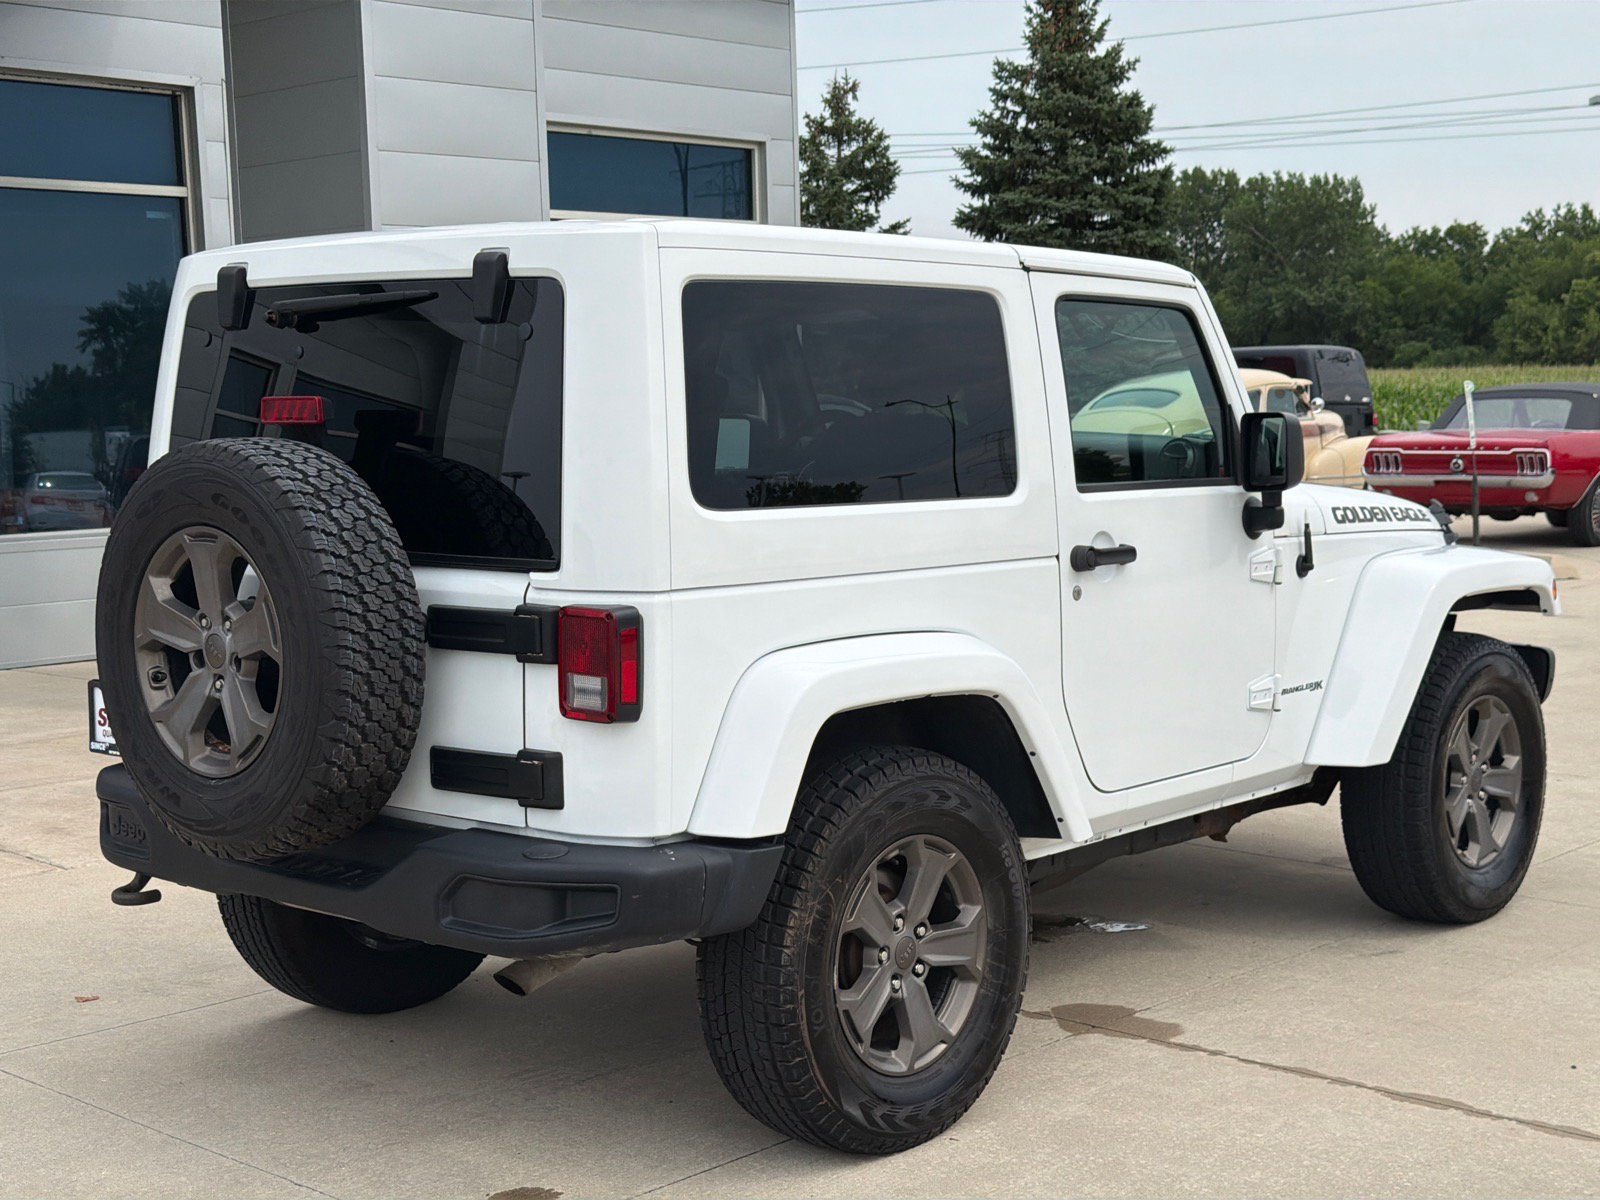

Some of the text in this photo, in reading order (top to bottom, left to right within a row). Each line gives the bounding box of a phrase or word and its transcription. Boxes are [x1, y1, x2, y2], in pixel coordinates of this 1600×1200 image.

[1331, 506, 1431, 524] GOLDEN EAGLE
[113, 814, 146, 844] Jeep
